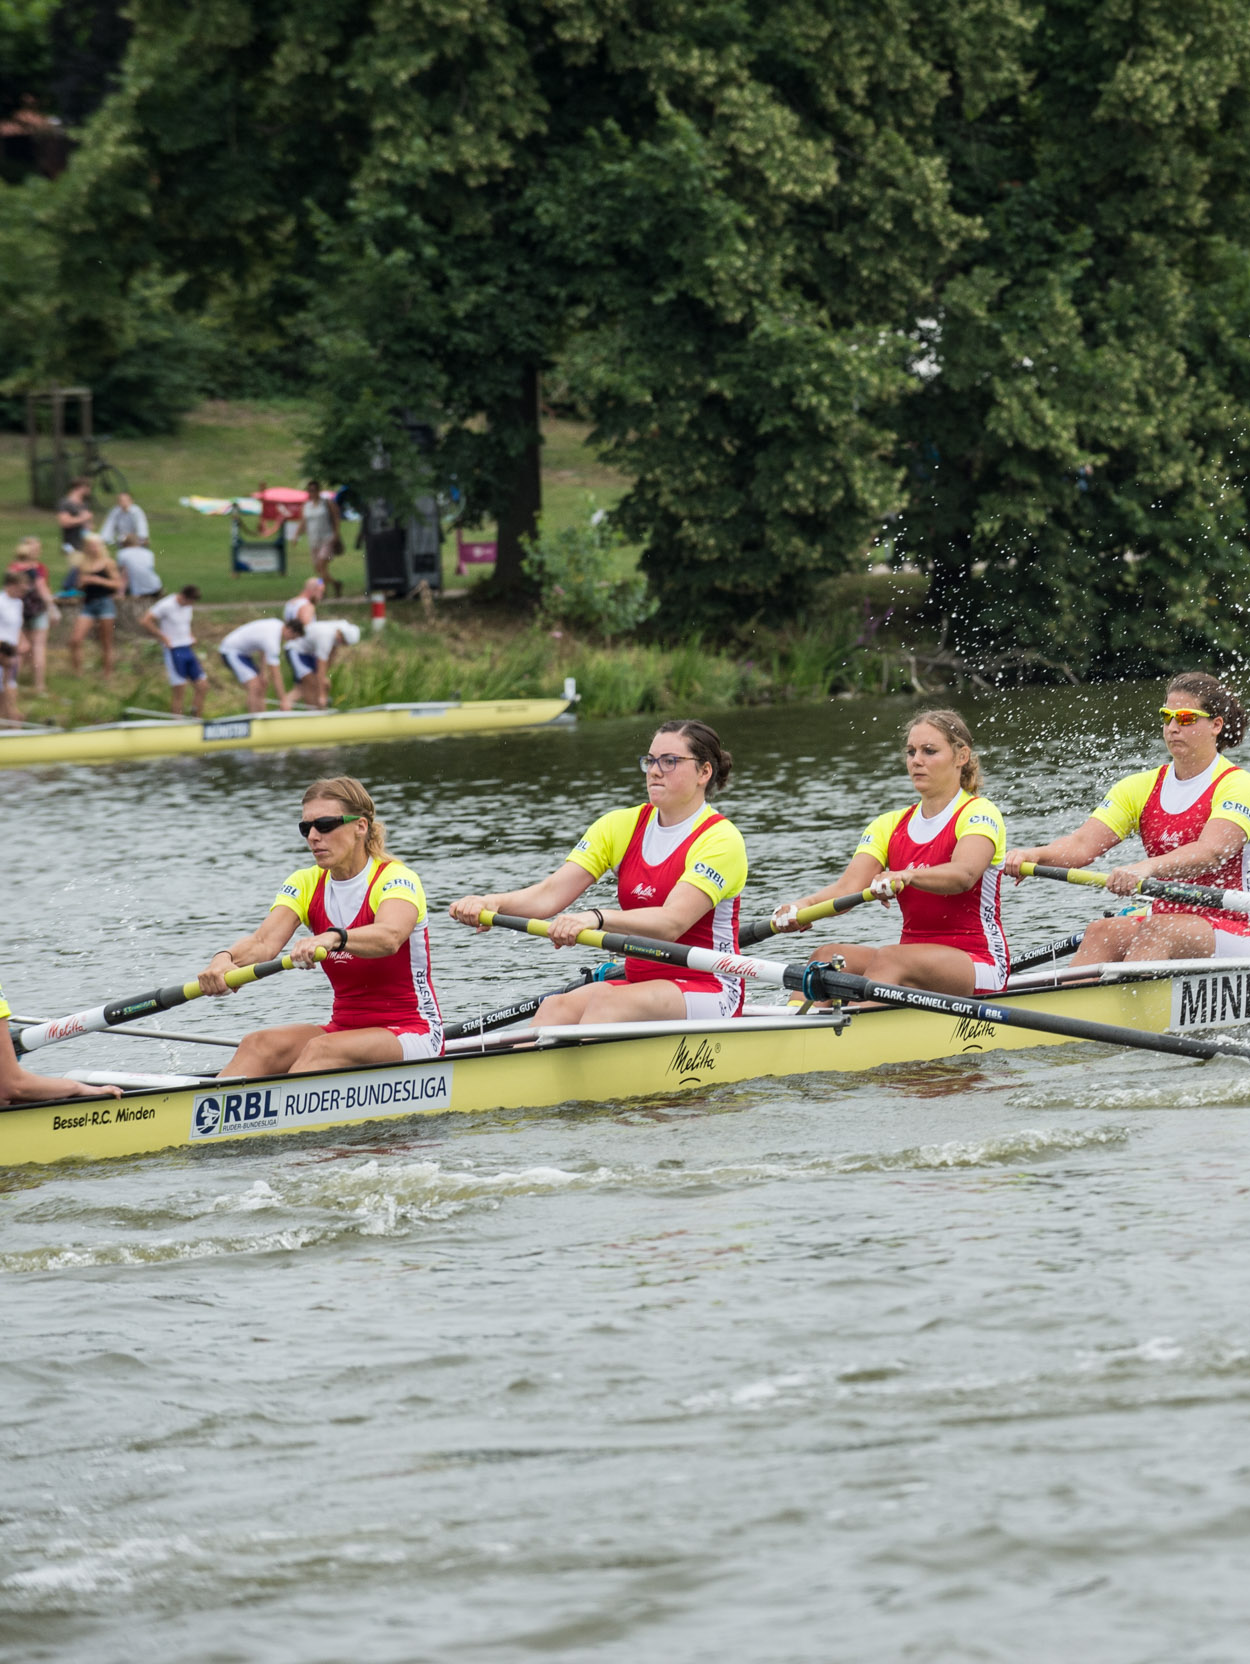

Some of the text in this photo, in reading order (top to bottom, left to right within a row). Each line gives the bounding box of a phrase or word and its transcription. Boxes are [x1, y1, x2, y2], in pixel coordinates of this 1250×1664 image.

[394, 878, 416, 893] RBL
[705, 866, 726, 889] RBL
[712, 954, 760, 979] Melitta
[486, 1007, 520, 1025] SCHNELL.
[519, 1000, 536, 1014] GUT.
[873, 987, 1003, 1019] STARK. SCHNELL. GUT. RBL
[44, 1015, 88, 1041] Melitta
[950, 1016, 996, 1043] Melitta
[665, 1036, 717, 1077] Melitta
[224, 1089, 278, 1124] RBL
[285, 1076, 447, 1117] RUDER-BUNDESLIGA
[53, 1106, 156, 1131] Bessel-R.C. Minden
[222, 1118, 278, 1132] RUDER-BUNDESLIGA
